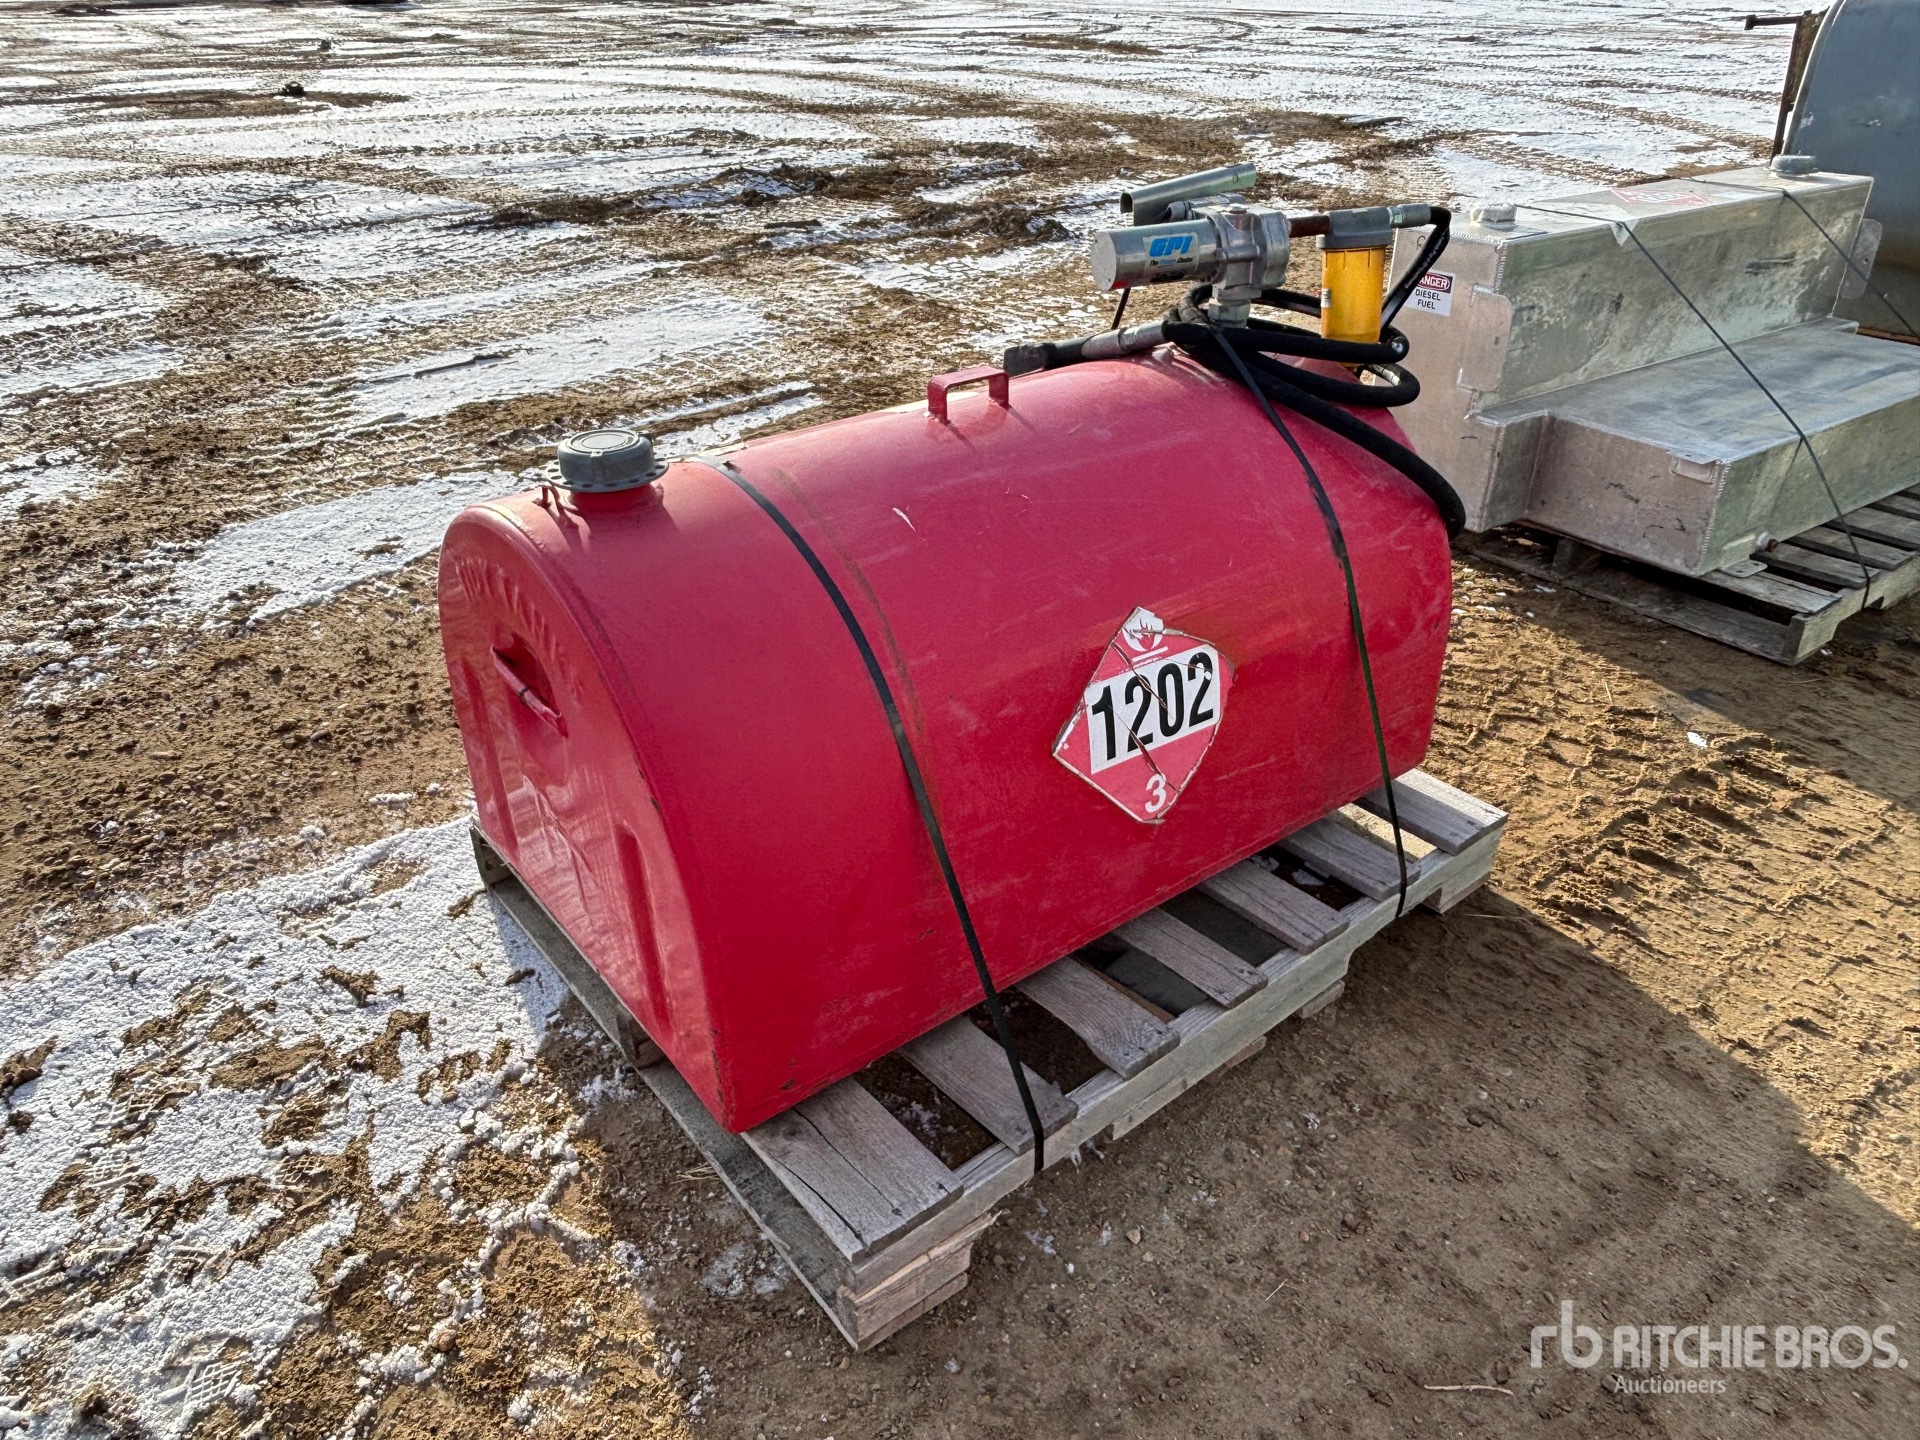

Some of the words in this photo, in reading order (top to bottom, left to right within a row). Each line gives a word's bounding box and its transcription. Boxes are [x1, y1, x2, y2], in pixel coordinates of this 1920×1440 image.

[1149, 236, 1193, 257] GPI
[1419, 275, 1447, 288] ANGER
[1415, 289, 1440, 301] DIESEL
[1417, 299, 1435, 309] FUEL
[1092, 652, 1214, 761] 1202
[1144, 773, 1166, 813] 3
